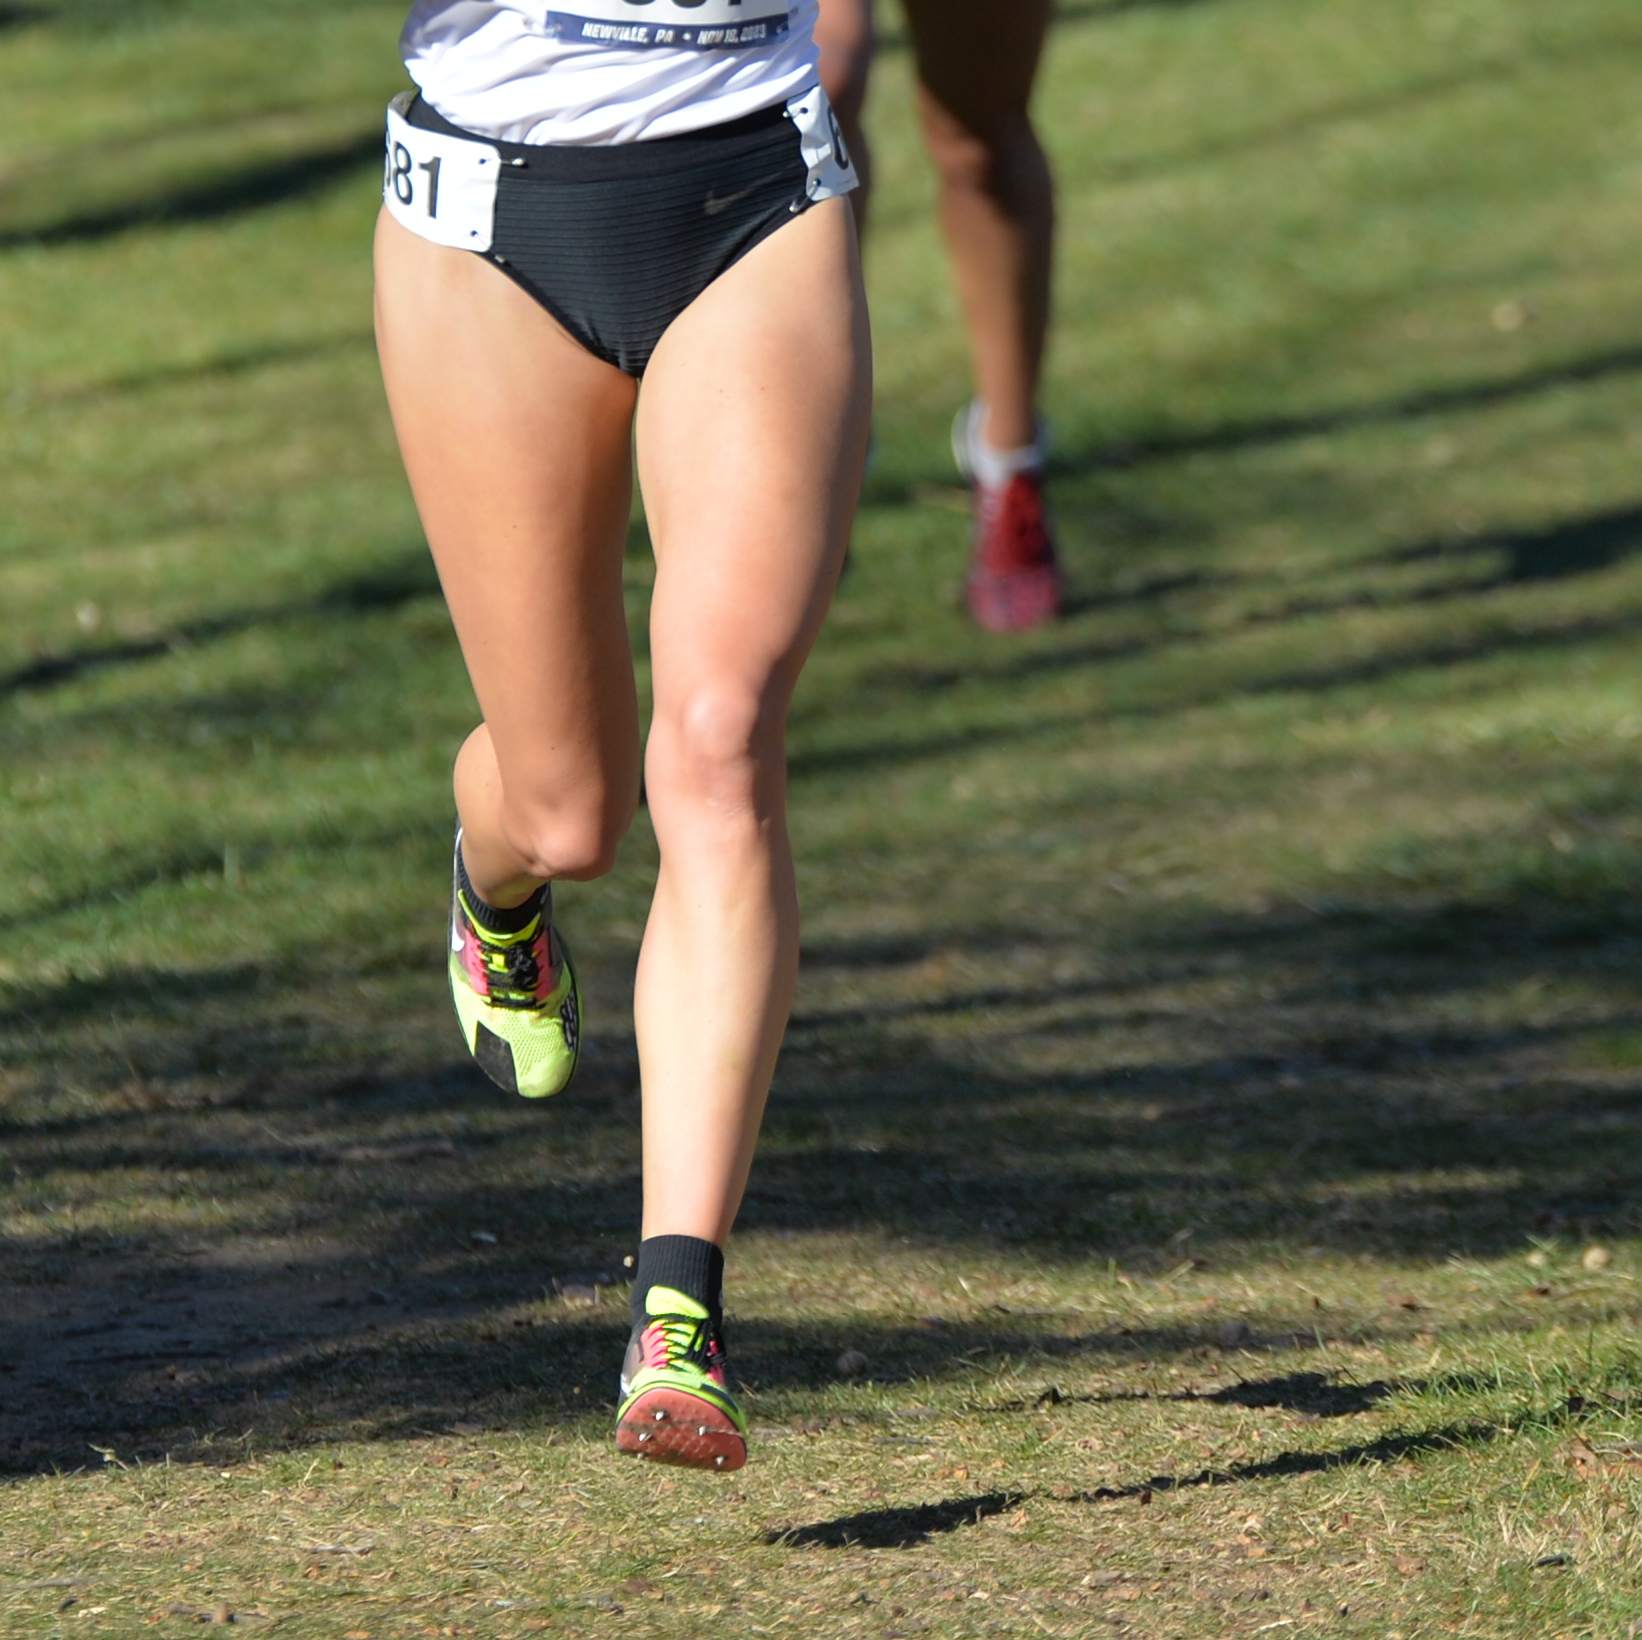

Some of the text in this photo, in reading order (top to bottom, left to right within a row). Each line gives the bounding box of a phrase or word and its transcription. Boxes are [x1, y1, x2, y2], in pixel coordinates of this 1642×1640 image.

[581, 21, 649, 44] NEWVILLE,
[654, 29, 675, 44] PA
[696, 29, 724, 45] NOV
